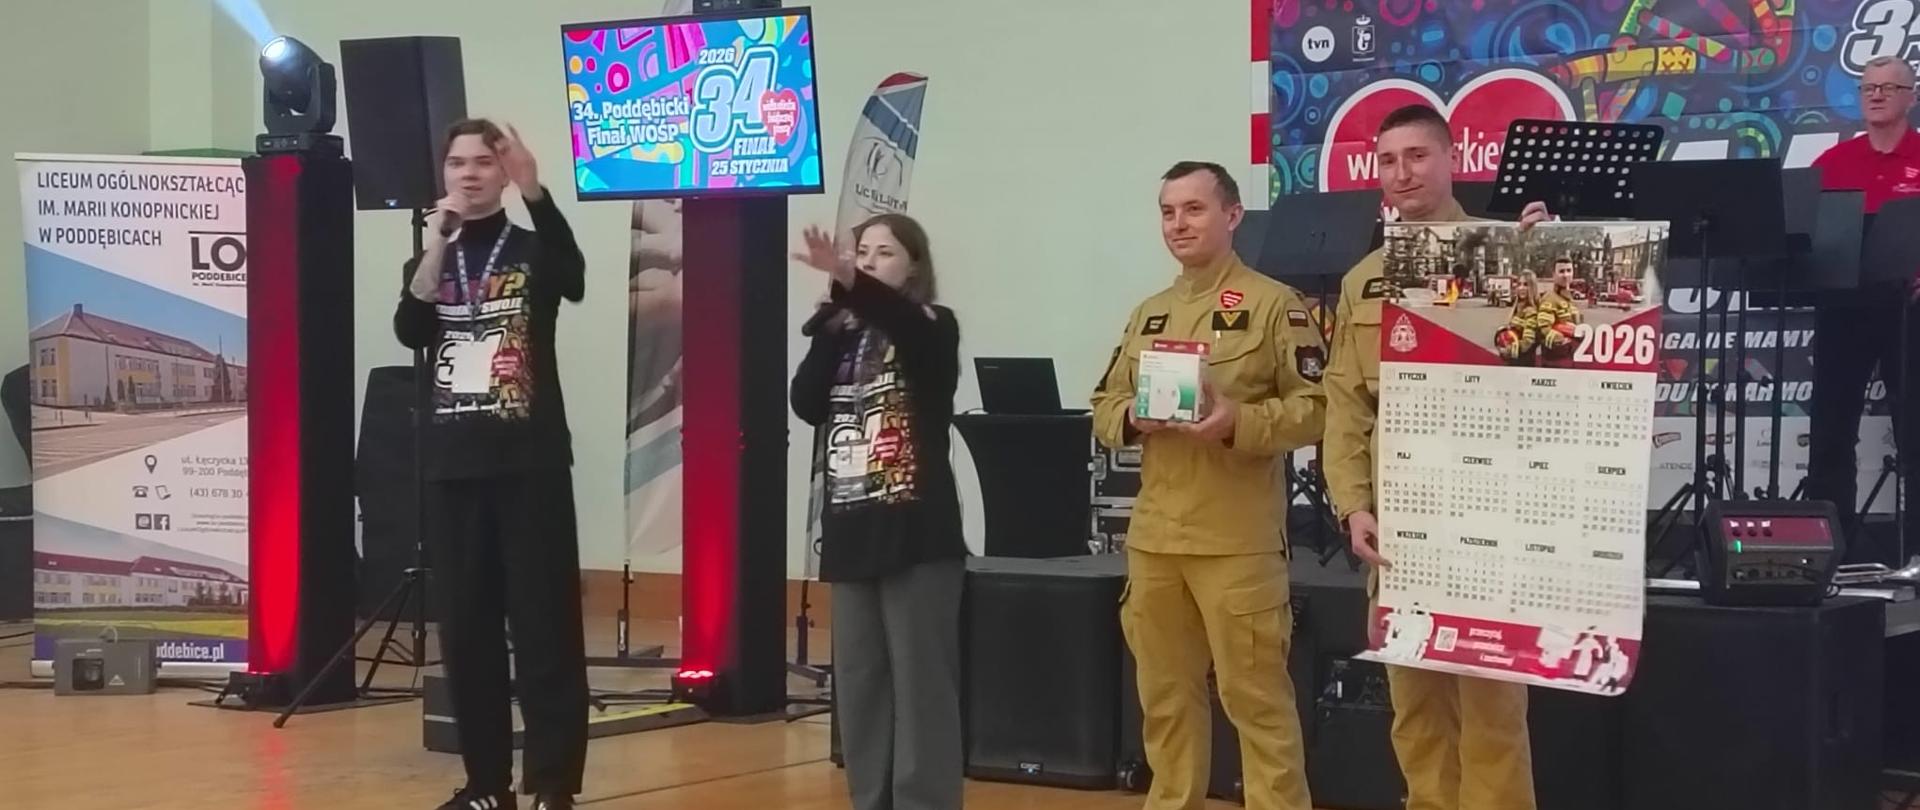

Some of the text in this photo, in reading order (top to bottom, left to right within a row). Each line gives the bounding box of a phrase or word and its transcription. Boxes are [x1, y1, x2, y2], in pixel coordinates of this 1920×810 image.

[1308, 38, 1330, 49] tvn
[1841, 0, 1920, 76] 3
[699, 48, 734, 64] 2026
[574, 97, 689, 120] 34. Poddębicki
[691, 45, 778, 151] 34
[588, 121, 679, 145] Finał WOŚP
[733, 137, 776, 156] FINAŁ
[711, 158, 788, 175] 25 STYCZNIA
[38, 170, 244, 198] LICEUM OGÓLNOKSZTAŁCĄC
[38, 200, 219, 220] IM. MARII KONOPNICKIEJ
[39, 228, 162, 249] W PODDĘBICACH
[190, 236, 247, 271] LO
[1573, 323, 1655, 365] 2026
[190, 488, 208, 498] (43)
